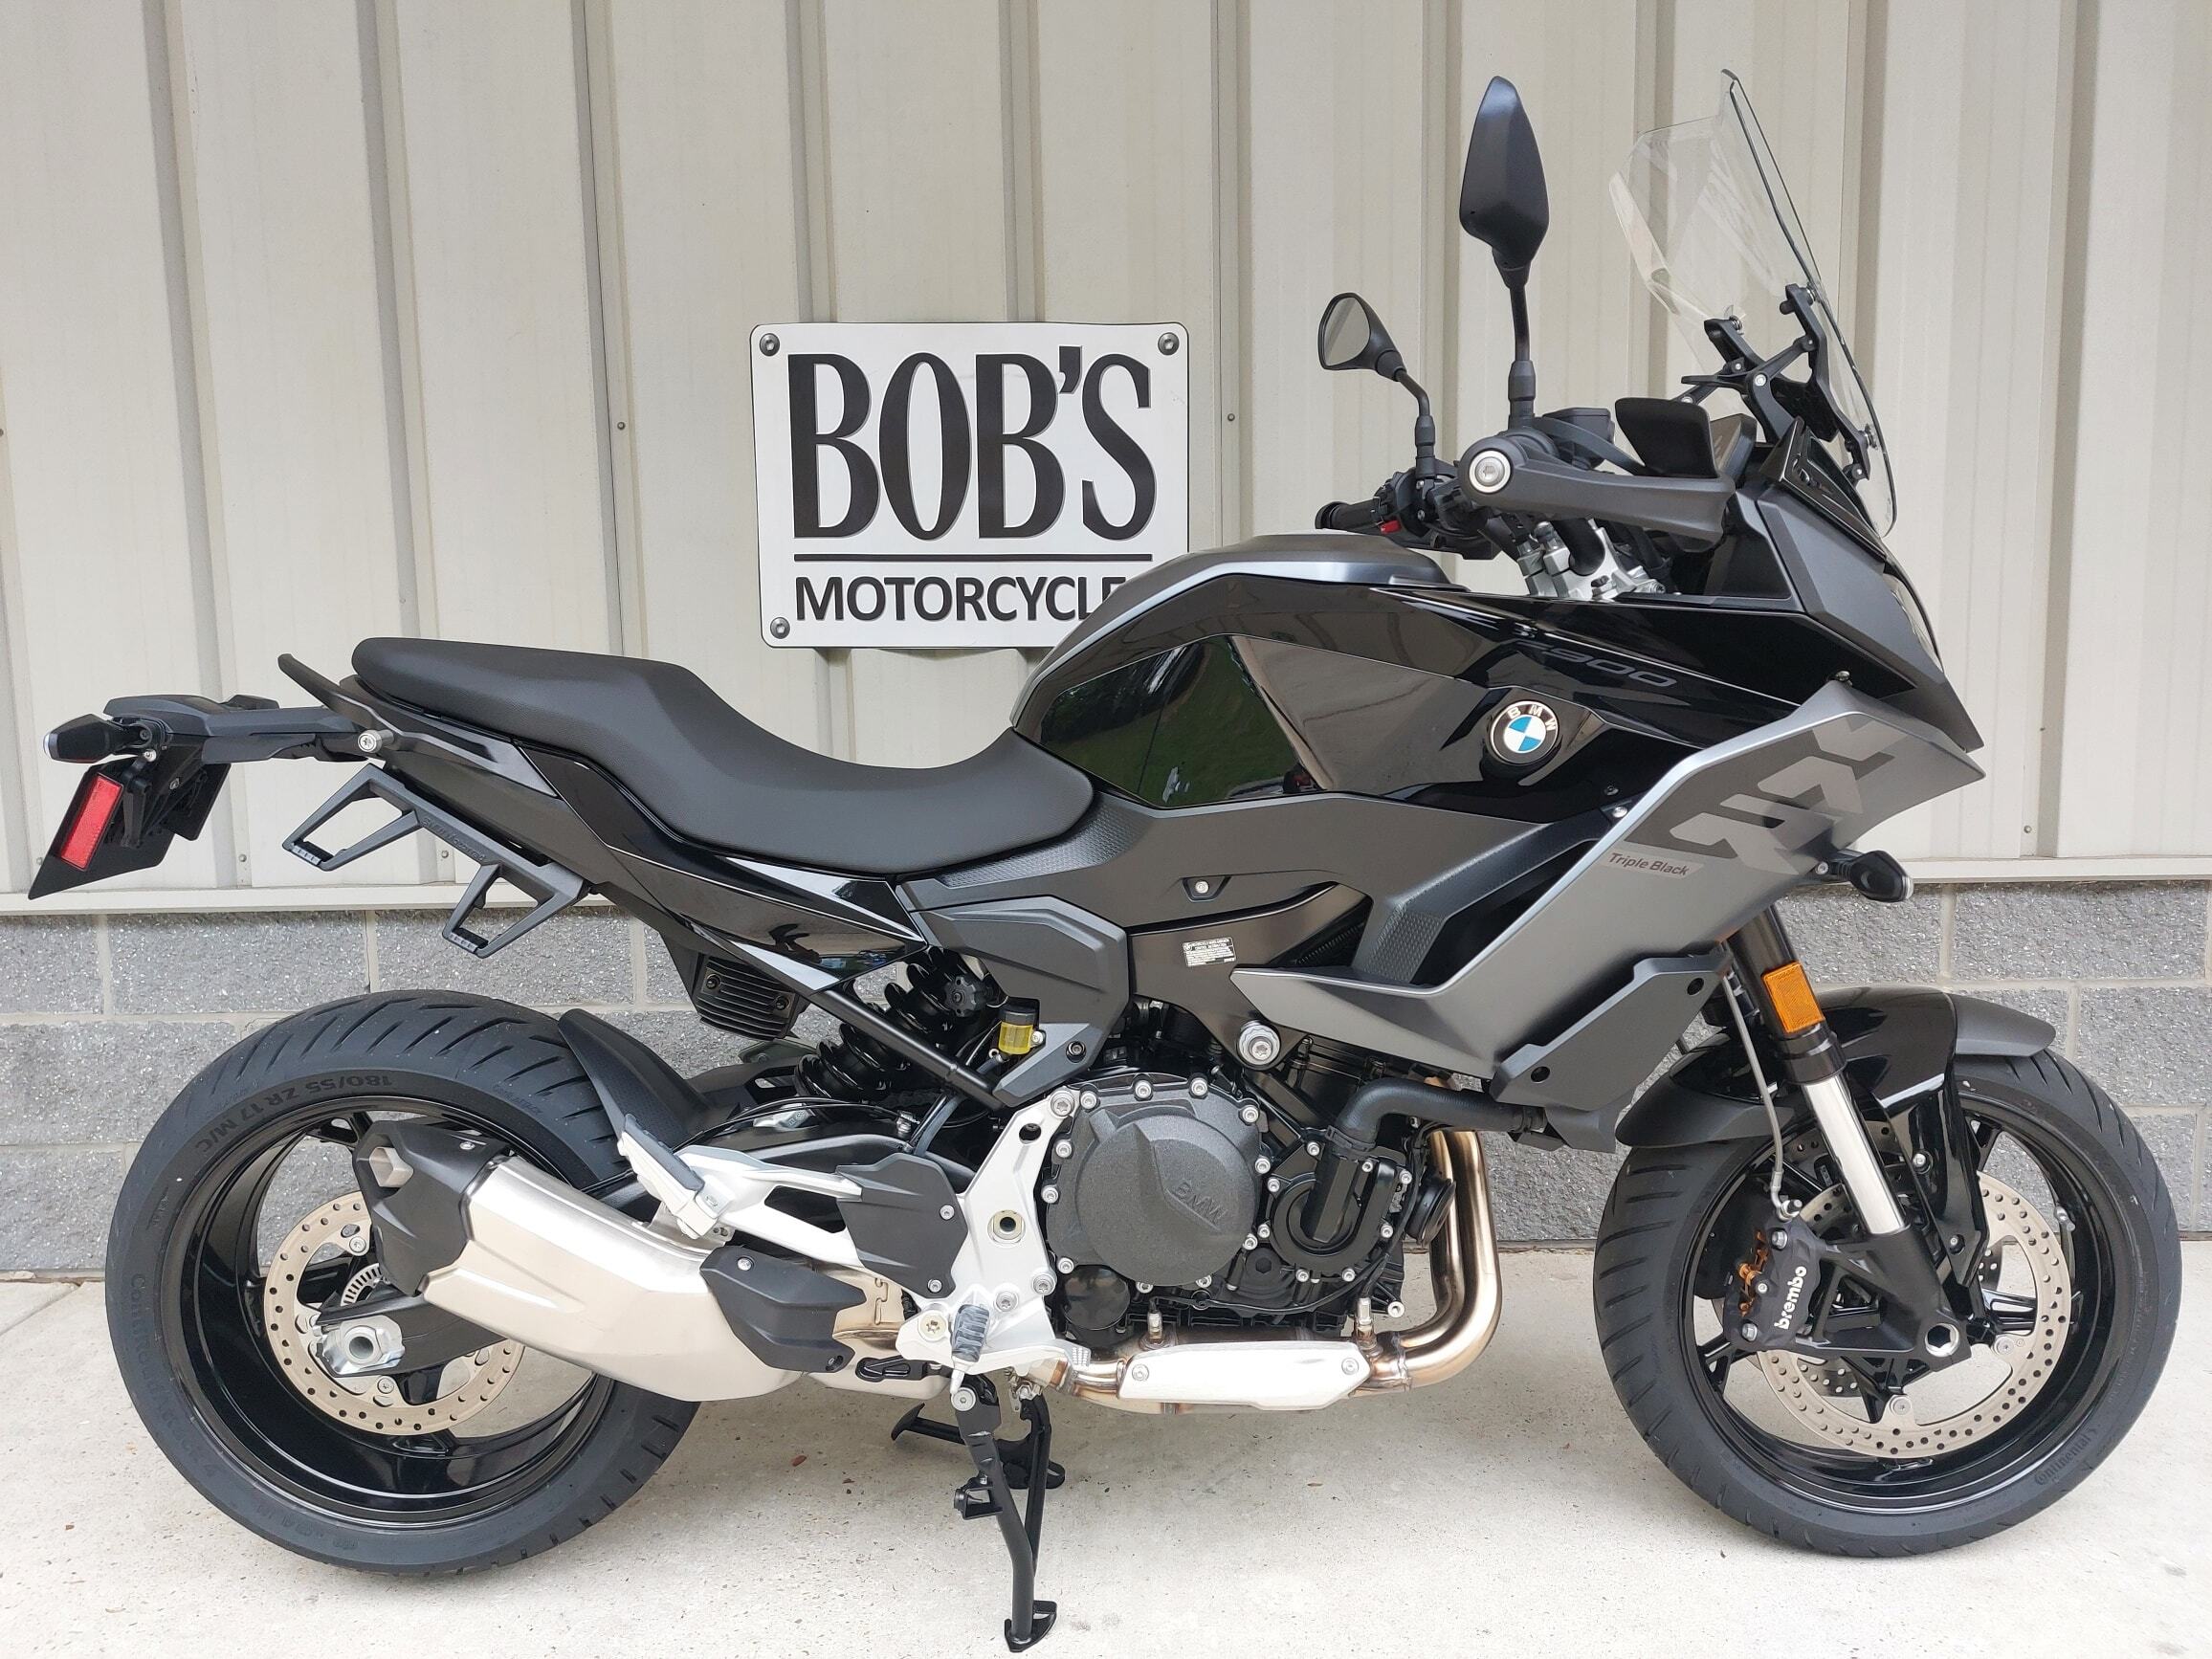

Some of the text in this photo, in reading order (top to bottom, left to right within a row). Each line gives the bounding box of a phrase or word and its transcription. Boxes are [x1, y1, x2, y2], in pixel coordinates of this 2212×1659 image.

[788, 345, 1157, 541] BOB'S
[1507, 703, 1557, 732] BMW
[1609, 852, 1690, 875] Triple Black
[194, 1074, 393, 1153] 180/55 ZR 17 M/C
[1172, 1181, 1229, 1226] BMW
[1773, 1266, 1807, 1330] brembo
